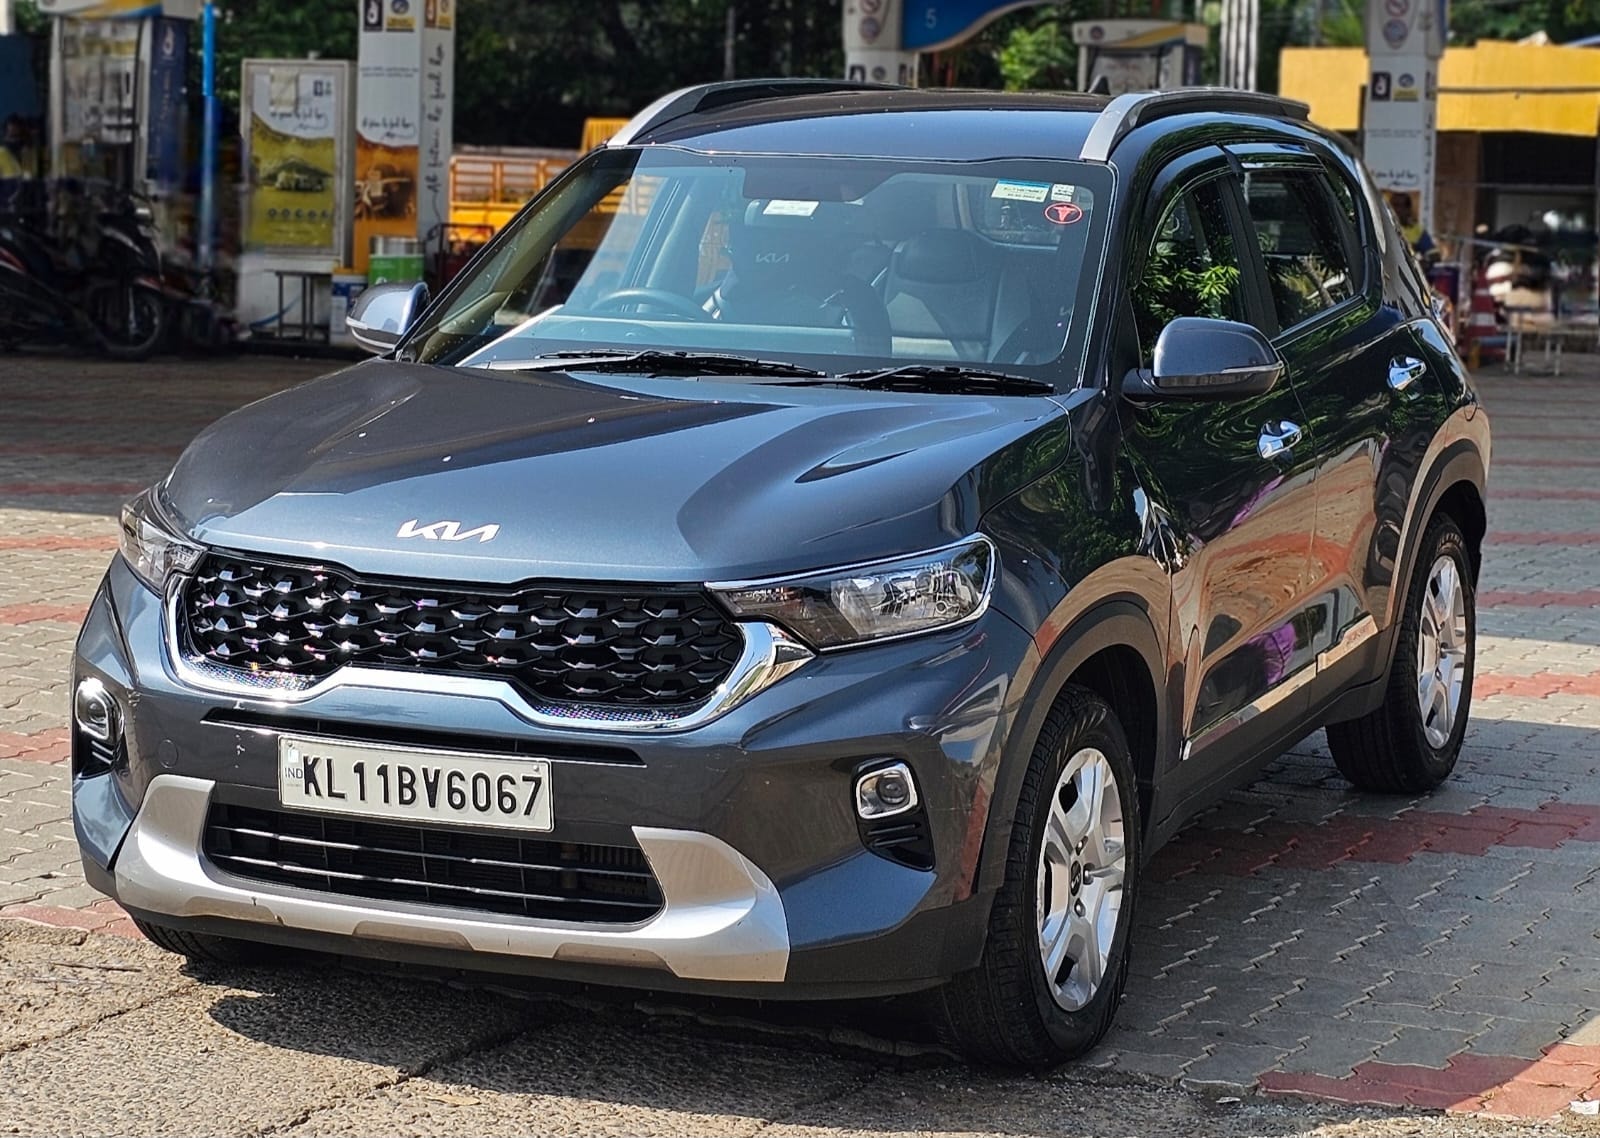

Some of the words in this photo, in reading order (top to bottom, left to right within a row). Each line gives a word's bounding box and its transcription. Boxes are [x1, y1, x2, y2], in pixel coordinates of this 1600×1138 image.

[925, 8, 937, 29] 5
[396, 519, 500, 543] KIA
[284, 767, 303, 779] IND
[303, 755, 542, 816] KL11BV6067
